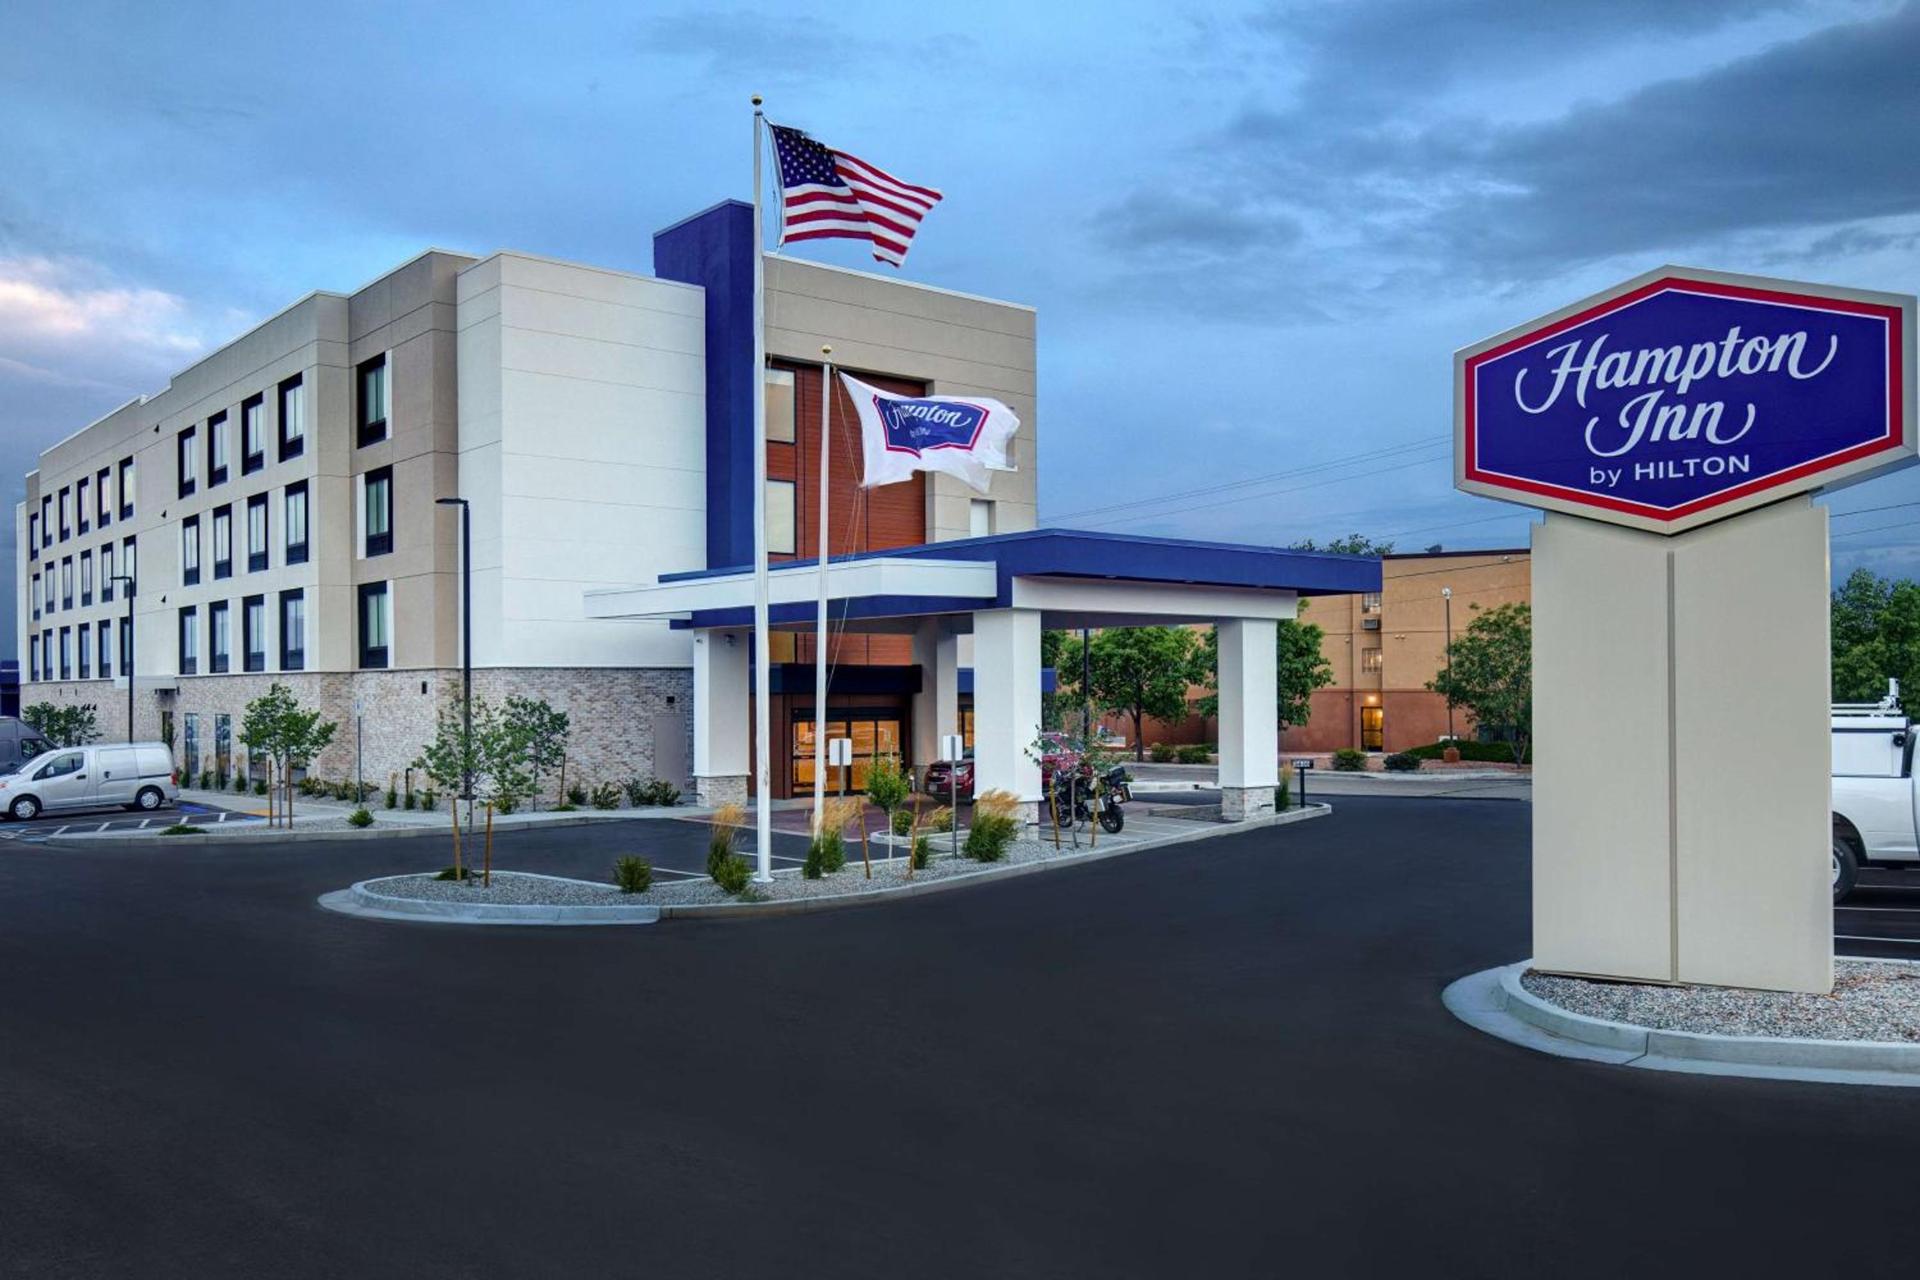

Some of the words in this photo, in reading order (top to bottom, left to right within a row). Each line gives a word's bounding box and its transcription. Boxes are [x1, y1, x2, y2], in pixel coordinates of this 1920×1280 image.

[1515, 327, 1837, 414] Hampton
[1585, 391, 1755, 457] Inn
[1590, 466, 1622, 487] by
[1635, 455, 1750, 480] HILTON
